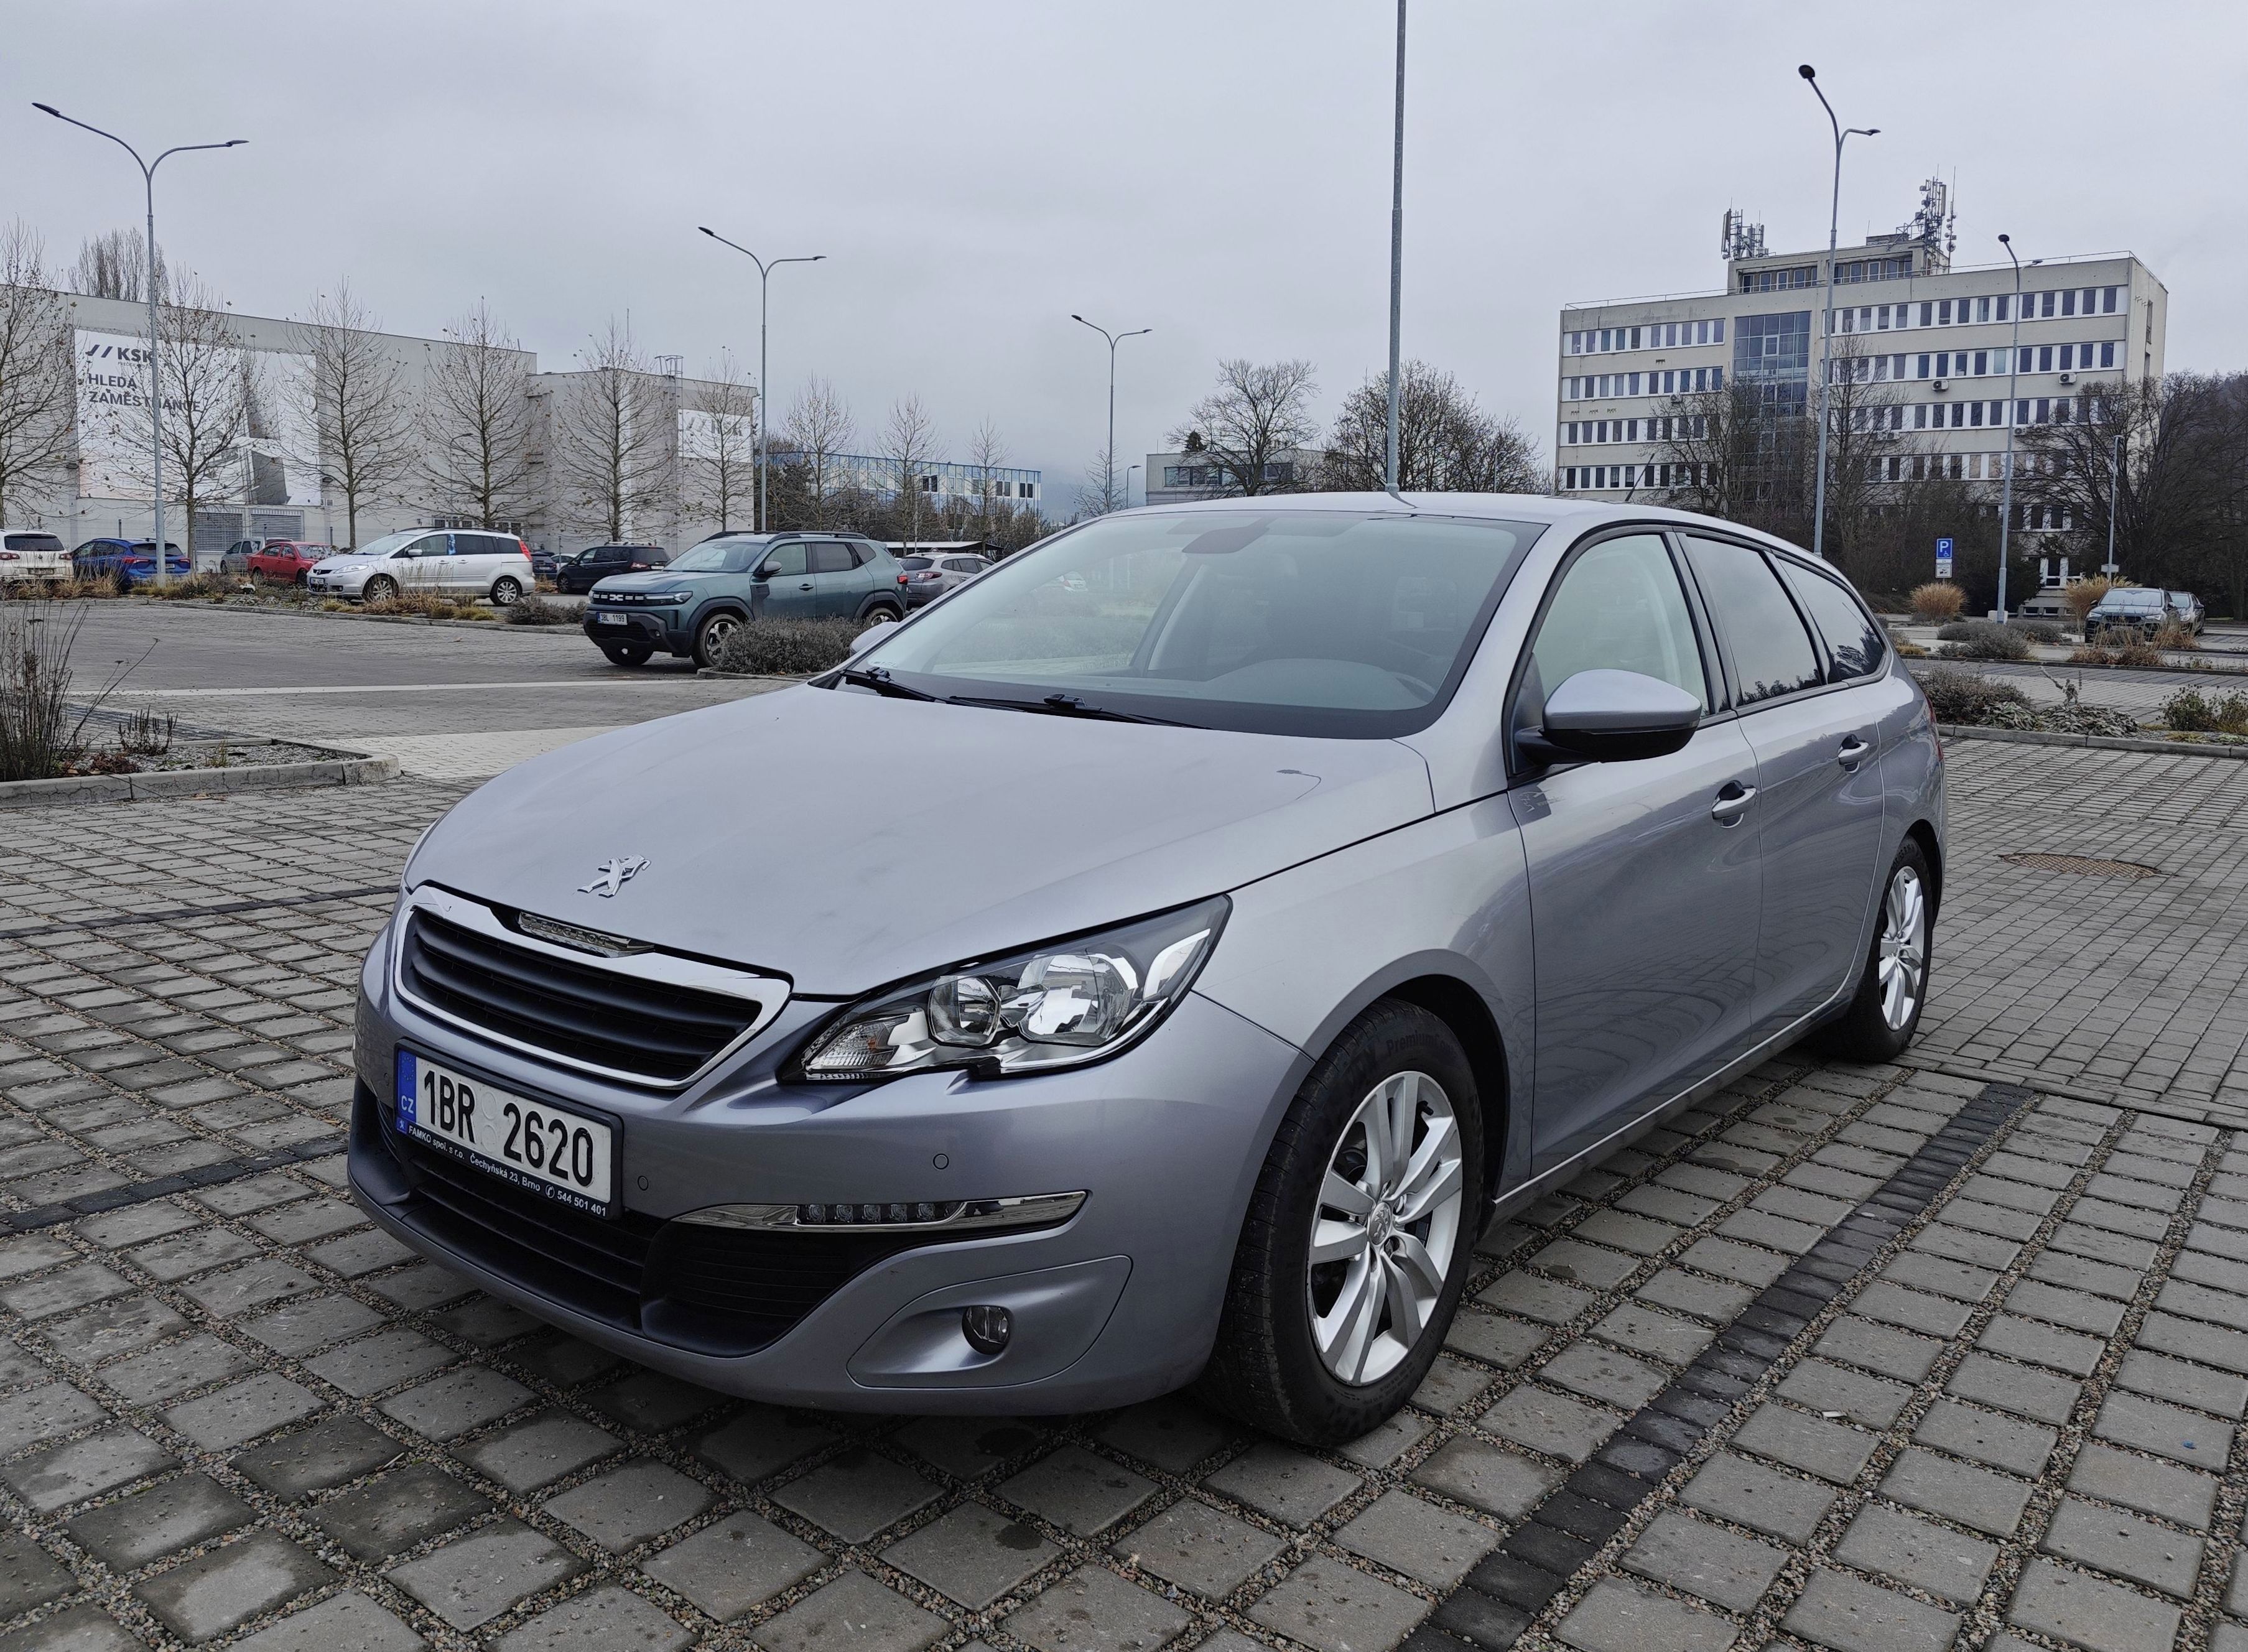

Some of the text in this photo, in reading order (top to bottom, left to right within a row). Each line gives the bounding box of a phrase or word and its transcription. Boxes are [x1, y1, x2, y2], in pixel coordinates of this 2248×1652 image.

[118, 347, 153, 363] KSK
[1940, 541, 1949, 553] P
[529, 917, 610, 947] PEUGEOT
[401, 1095, 414, 1114] CZ
[424, 1070, 593, 1187] 1BR 2620
[409, 1125, 431, 1143] FAMKO
[454, 1149, 465, 1160] r.o.
[470, 1153, 508, 1179] Čechyňská
[509, 1171, 520, 1186] 23,
[522, 1176, 541, 1191] Brno
[557, 1190, 572, 1204] 544
[574, 1198, 588, 1210] 501
[591, 1204, 606, 1217] 401
